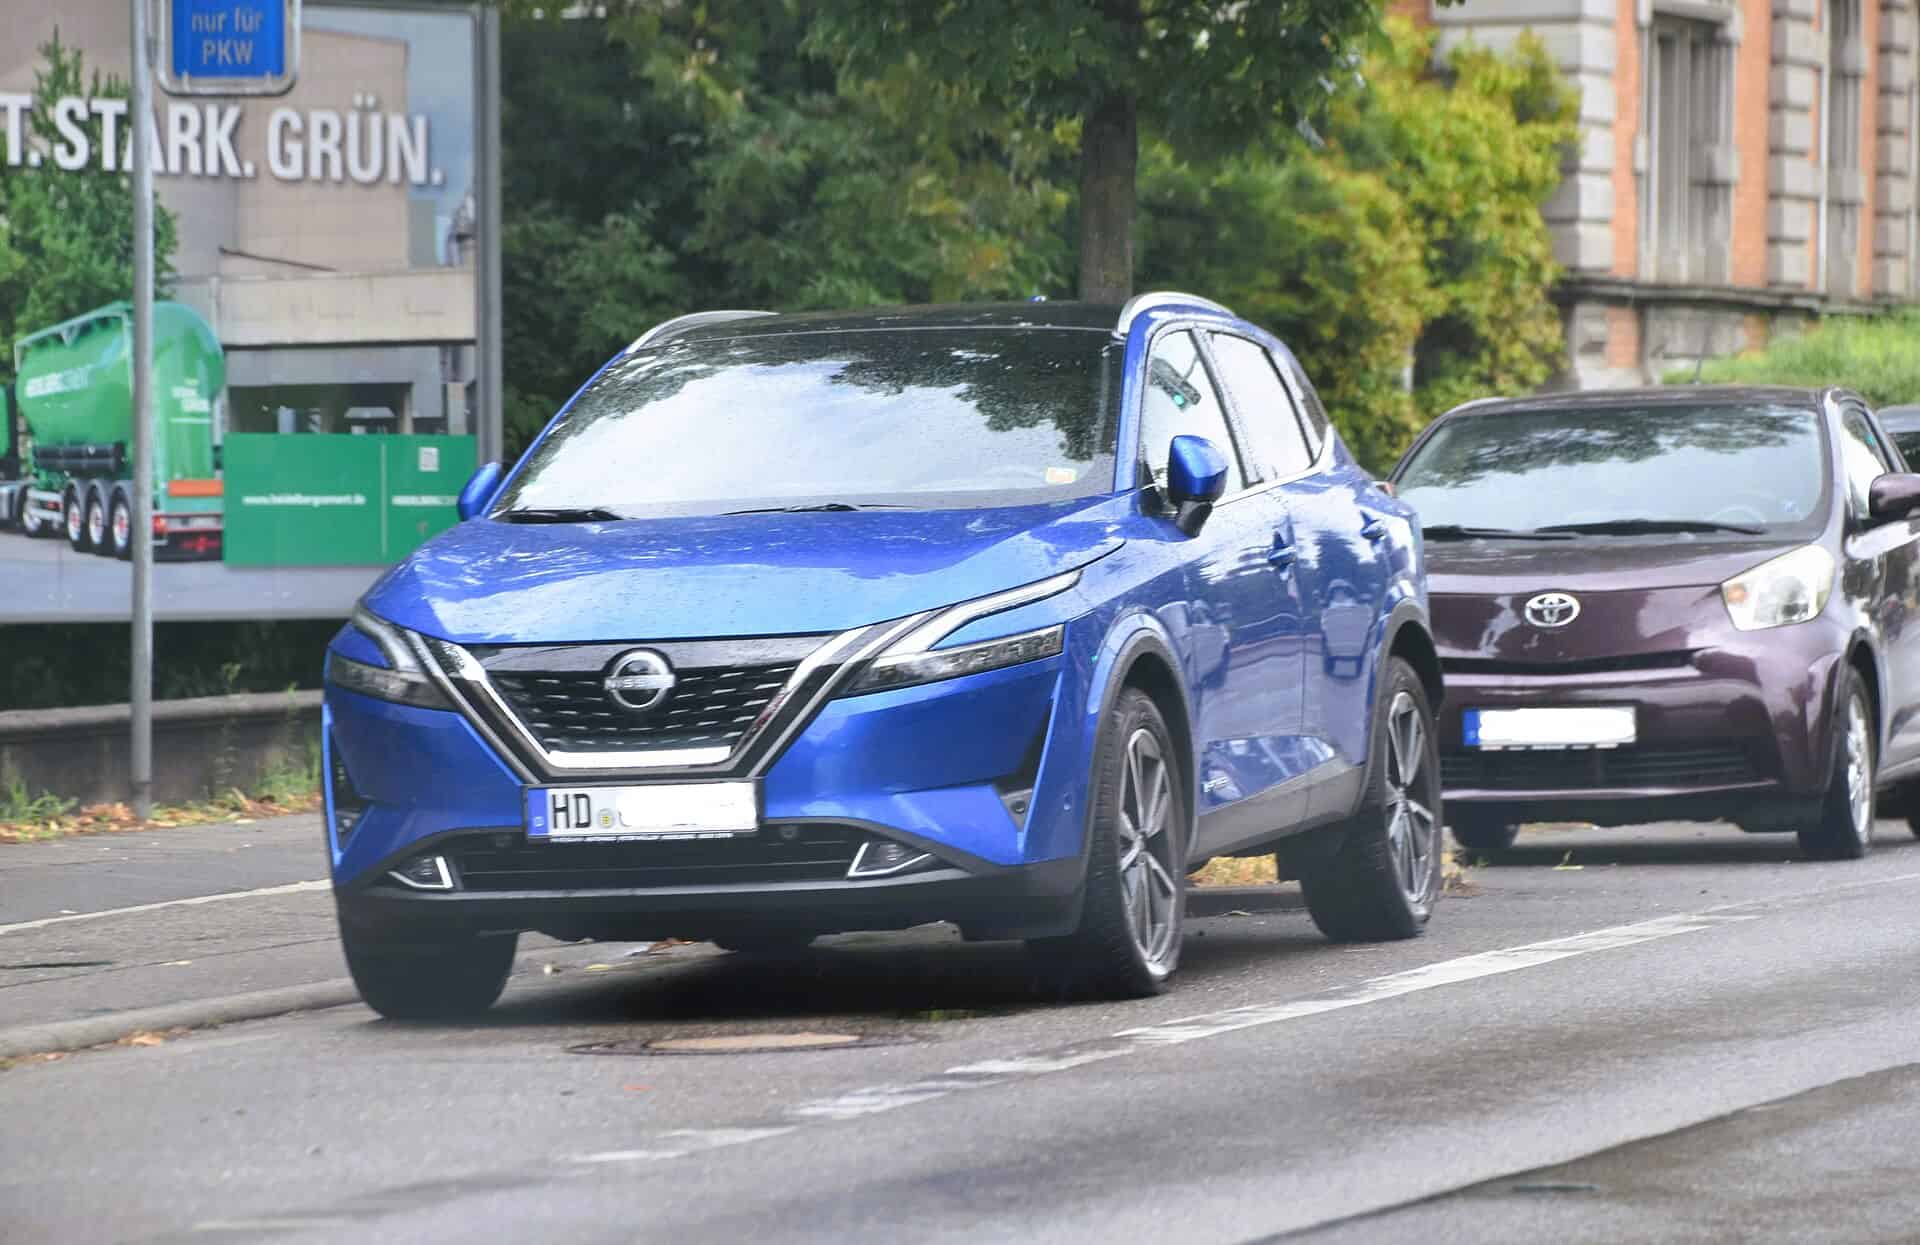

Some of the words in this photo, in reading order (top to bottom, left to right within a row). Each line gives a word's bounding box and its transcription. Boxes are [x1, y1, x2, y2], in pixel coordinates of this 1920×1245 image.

[192, 11, 227, 33] nur
[234, 7, 264, 33] für
[202, 39, 254, 65] PKW
[267, 94, 446, 185] GRÜN.
[551, 793, 592, 829] HD
